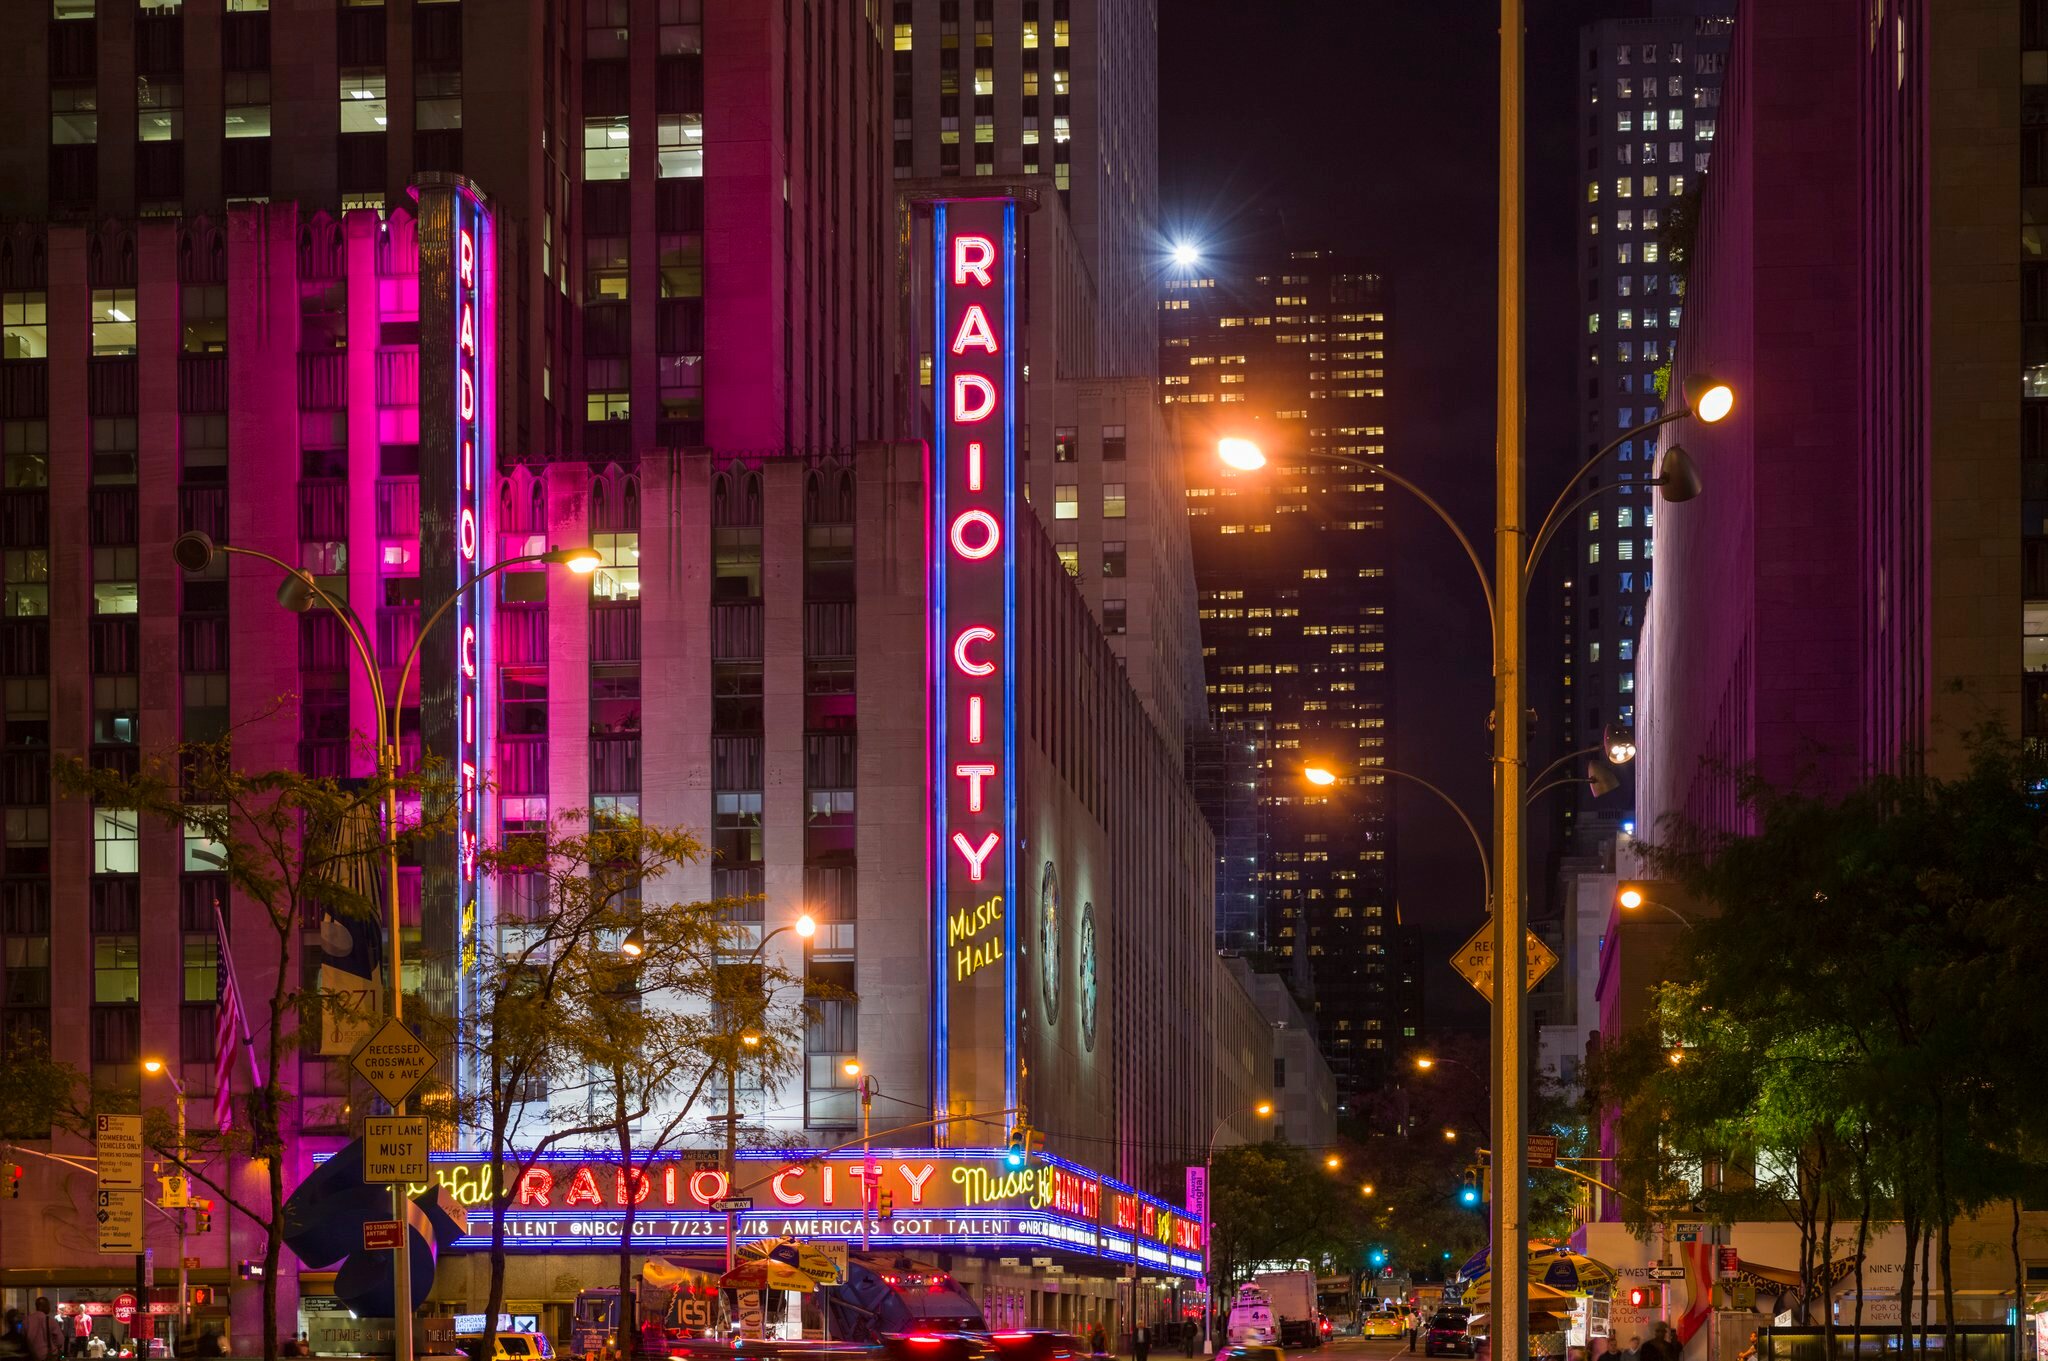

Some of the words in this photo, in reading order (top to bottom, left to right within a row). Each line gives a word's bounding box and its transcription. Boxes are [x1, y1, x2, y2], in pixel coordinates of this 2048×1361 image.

[460, 229, 475, 560] RADIO
[952, 235, 1001, 560] RADIO
[460, 627, 476, 882] CITY
[952, 626, 1001, 881] CITY
[950, 895, 1003, 947] MUSIC
[957, 936, 1003, 982] HALL
[1469, 955, 1542, 967] CROLK
[369, 1044, 420, 1055] RECESSED
[365, 1057, 425, 1068] CROSSWALK
[370, 1070, 384, 1080] ON
[389, 1070, 395, 1079] 6
[400, 1069, 420, 1079] AVE
[99, 1116, 107, 1130] 3
[369, 1125, 392, 1136] LEFT
[397, 1125, 423, 1136] LANE
[1528, 1138, 1554, 1146] TANDING
[379, 1143, 413, 1156] MUST
[369, 1163, 395, 1175] TURN
[400, 1163, 424, 1174] LEFT
[520, 1166, 729, 1206] RADIO
[771, 1163, 935, 1206] CITY
[951, 1165, 1034, 1207] Music
[99, 1191, 108, 1206] 6
[1055, 1170, 1081, 1214] RADIO
[1082, 1180, 1098, 1219] CITY
[1196, 1176, 1204, 1215] hanghai
[366, 1229, 388, 1237] ANYTIME
[488, 1221, 558, 1237] ALENT
[569, 1221, 657, 1237] @NBCGT
[893, 1219, 932, 1235] GOT
[946, 1219, 1011, 1235] TALENT
[1625, 1268, 1649, 1277] WEST
[1869, 1264, 1893, 1273] NINE
[1895, 1264, 1920, 1273] WT
[677, 1299, 711, 1326] IESI
[1624, 1307, 1639, 1315] OUR
[1870, 1304, 1887, 1312] FOR
[1252, 1311, 1260, 1320] 4
[1623, 1316, 1650, 1324] LOOK!
[1870, 1312, 1891, 1320] NEW
[1893, 1311, 1920, 1320] LOK!
[320, 1327, 361, 1342] TIME
[428, 1329, 440, 1342] TIME
